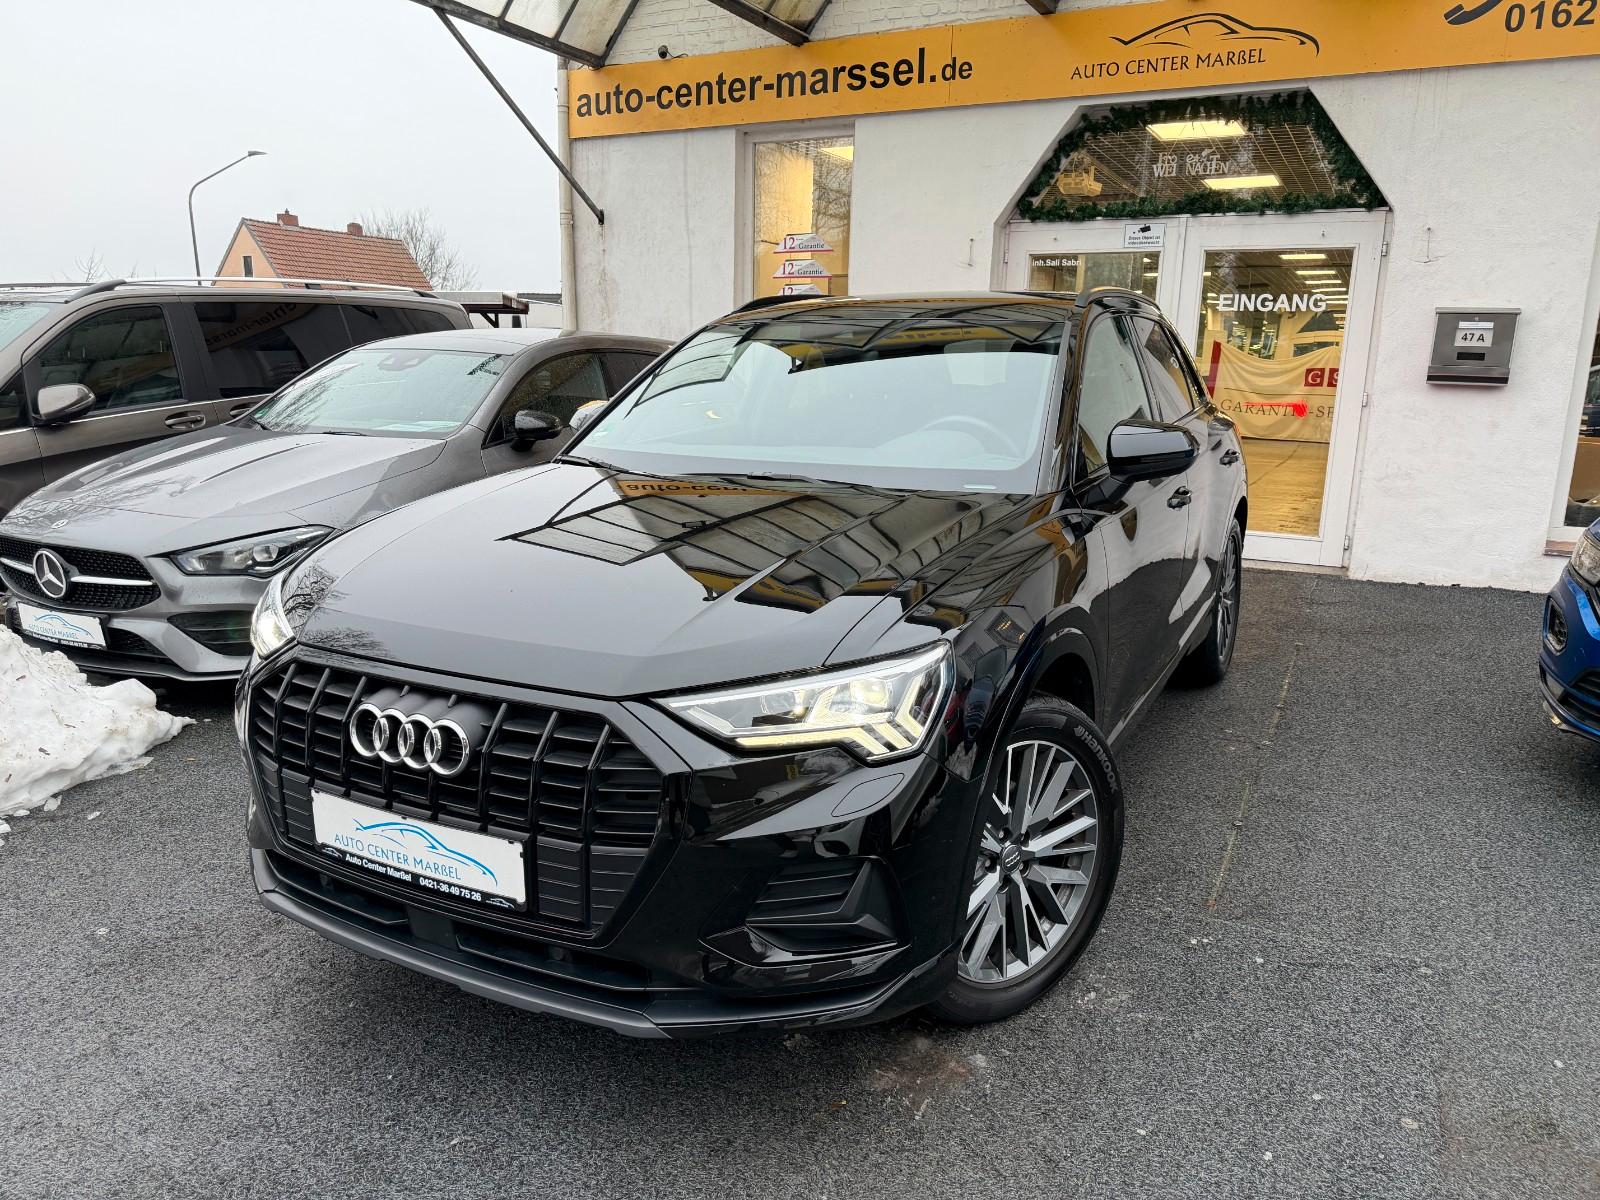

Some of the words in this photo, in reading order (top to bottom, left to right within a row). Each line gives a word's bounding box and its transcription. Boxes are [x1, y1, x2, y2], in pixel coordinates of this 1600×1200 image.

[1504, 0, 1598, 33] 0162
[1070, 61, 1121, 80] AUTO
[1125, 54, 1190, 75] CENTER
[576, 46, 973, 118] auto-center-marssel.de
[783, 236, 796, 250] 12
[798, 242, 825, 250] Garantie
[782, 262, 795, 275] 12
[1061, 258, 1082, 266] Sabri
[1218, 293, 1328, 313] EINGANG
[1461, 332, 1475, 342] 47
[1476, 333, 1485, 343] A
[334, 831, 365, 852] AUTO
[367, 843, 410, 866] CENTER
[345, 853, 362, 867] Auto
[362, 858, 387, 875] Center
[387, 865, 412, 882] Marßel
[419, 877, 450, 894] 0421-36
[449, 884, 460, 896] 49
[460, 886, 471, 899] 75
[471, 889, 482, 902] 26
